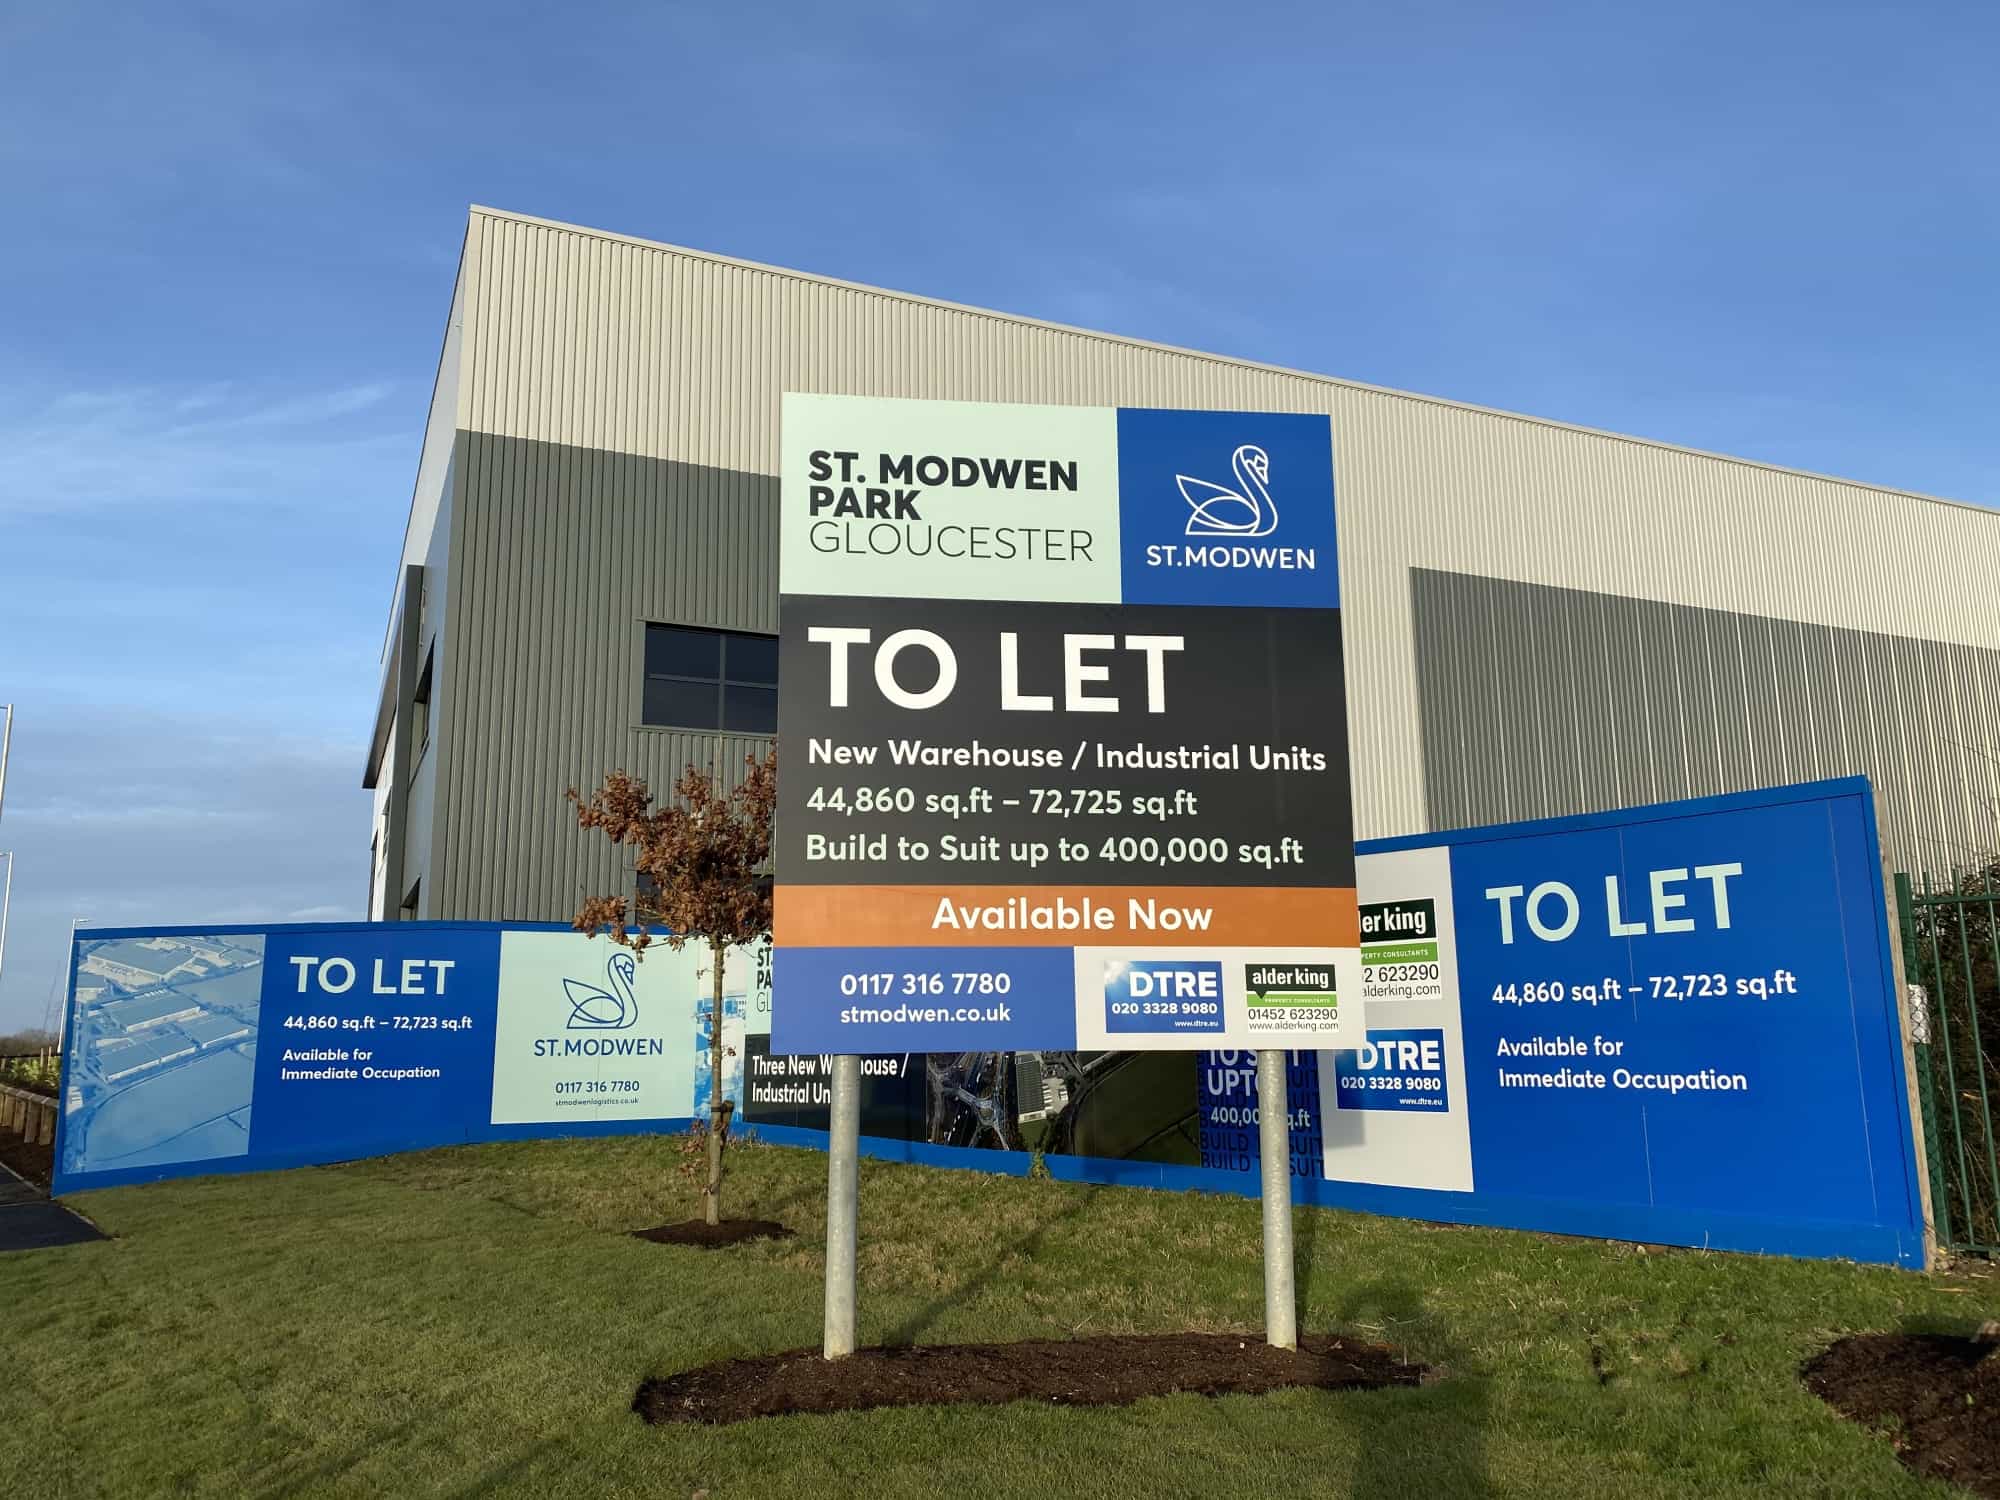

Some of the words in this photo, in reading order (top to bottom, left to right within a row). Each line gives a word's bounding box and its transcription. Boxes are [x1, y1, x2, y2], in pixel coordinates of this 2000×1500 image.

[808, 450, 866, 483] ST.
[879, 453, 1078, 491] MODWEN
[808, 485, 922, 520] PARK
[809, 520, 1094, 562] GLOUCESTER
[1146, 545, 1315, 569] ST.MODWEN
[807, 627, 958, 709] TO
[1000, 631, 1185, 713] LET
[808, 738, 878, 765] New
[887, 739, 1064, 768] Warehouse
[1071, 740, 1087, 770] /
[1097, 743, 1239, 769] Industrial
[1249, 745, 1327, 770] Units
[806, 786, 915, 816] 44,860
[925, 786, 993, 819] sq.ft
[1029, 789, 1122, 818] 72,725
[1132, 789, 1198, 821] sq.ft
[806, 834, 887, 861] Build
[898, 837, 929, 861] to
[940, 835, 1000, 861] Suit
[1010, 841, 1048, 867] up
[1058, 837, 1090, 862] to
[1099, 837, 1229, 866] 400,000
[1238, 837, 1304, 869] sq.ft
[931, 897, 1115, 929] Available
[1128, 898, 1213, 930] Now
[1485, 881, 1580, 945] TO
[1605, 862, 1743, 937] LET
[290, 956, 356, 993] TO
[372, 959, 455, 995] LET
[757, 970, 773, 990] PA
[840, 973, 894, 995] 0117
[902, 973, 944, 995] 316
[951, 972, 1011, 994] 7780
[1378, 964, 1439, 982] 623290
[1128, 971, 1218, 998] DTRE
[1363, 983, 1441, 998] alderking.com
[1492, 981, 1565, 1006] 44,860
[1571, 978, 1621, 1006] sq.ft
[1649, 974, 1728, 1000] 72,723
[1736, 969, 1798, 1000] sq.ft
[840, 1002, 1011, 1023] stmodwen.co.uk
[1111, 1003, 1139, 1014] 020
[1143, 1003, 1178, 1014] 3328
[1182, 1003, 1218, 1014] 9080
[1248, 1008, 1285, 1020] 01452
[1290, 1008, 1338, 1020] 623290
[284, 1016, 337, 1030] 44,860
[342, 1016, 375, 1031] sq.ft
[393, 1016, 438, 1030] 72,723
[441, 1016, 472, 1031] sq.ft
[1174, 1019, 1218, 1027] www.dtre.eu
[1248, 1021, 1339, 1032] www.alderking.com
[283, 1048, 349, 1061] Available
[353, 1048, 373, 1061] for
[534, 1038, 663, 1056] ST.MODWEN
[1357, 1040, 1440, 1071] DTRE
[1497, 1036, 1588, 1056] Available
[1594, 1035, 1624, 1055] for
[281, 1067, 358, 1080] Immediate
[362, 1067, 440, 1081] Occupation
[752, 1055, 785, 1075] Three
[788, 1055, 816, 1075] New
[901, 1053, 909, 1078] /
[555, 1082, 582, 1093] 0117
[586, 1081, 607, 1092] 316
[611, 1080, 640, 1092] 7780
[752, 1082, 809, 1102] Industrial
[1341, 1076, 1366, 1089] 020
[1369, 1077, 1401, 1090] 3328
[1405, 1077, 1441, 1090] 9080
[1499, 1068, 1607, 1088] Immediate
[1612, 1068, 1749, 1094] Occupation
[555, 1097, 639, 1107] stmodwenlogistics.co.uk
[1399, 1097, 1443, 1106] www.dtre.eu
[1210, 1107, 1261, 1126] 400,00
[1287, 1108, 1311, 1131] q.ft
